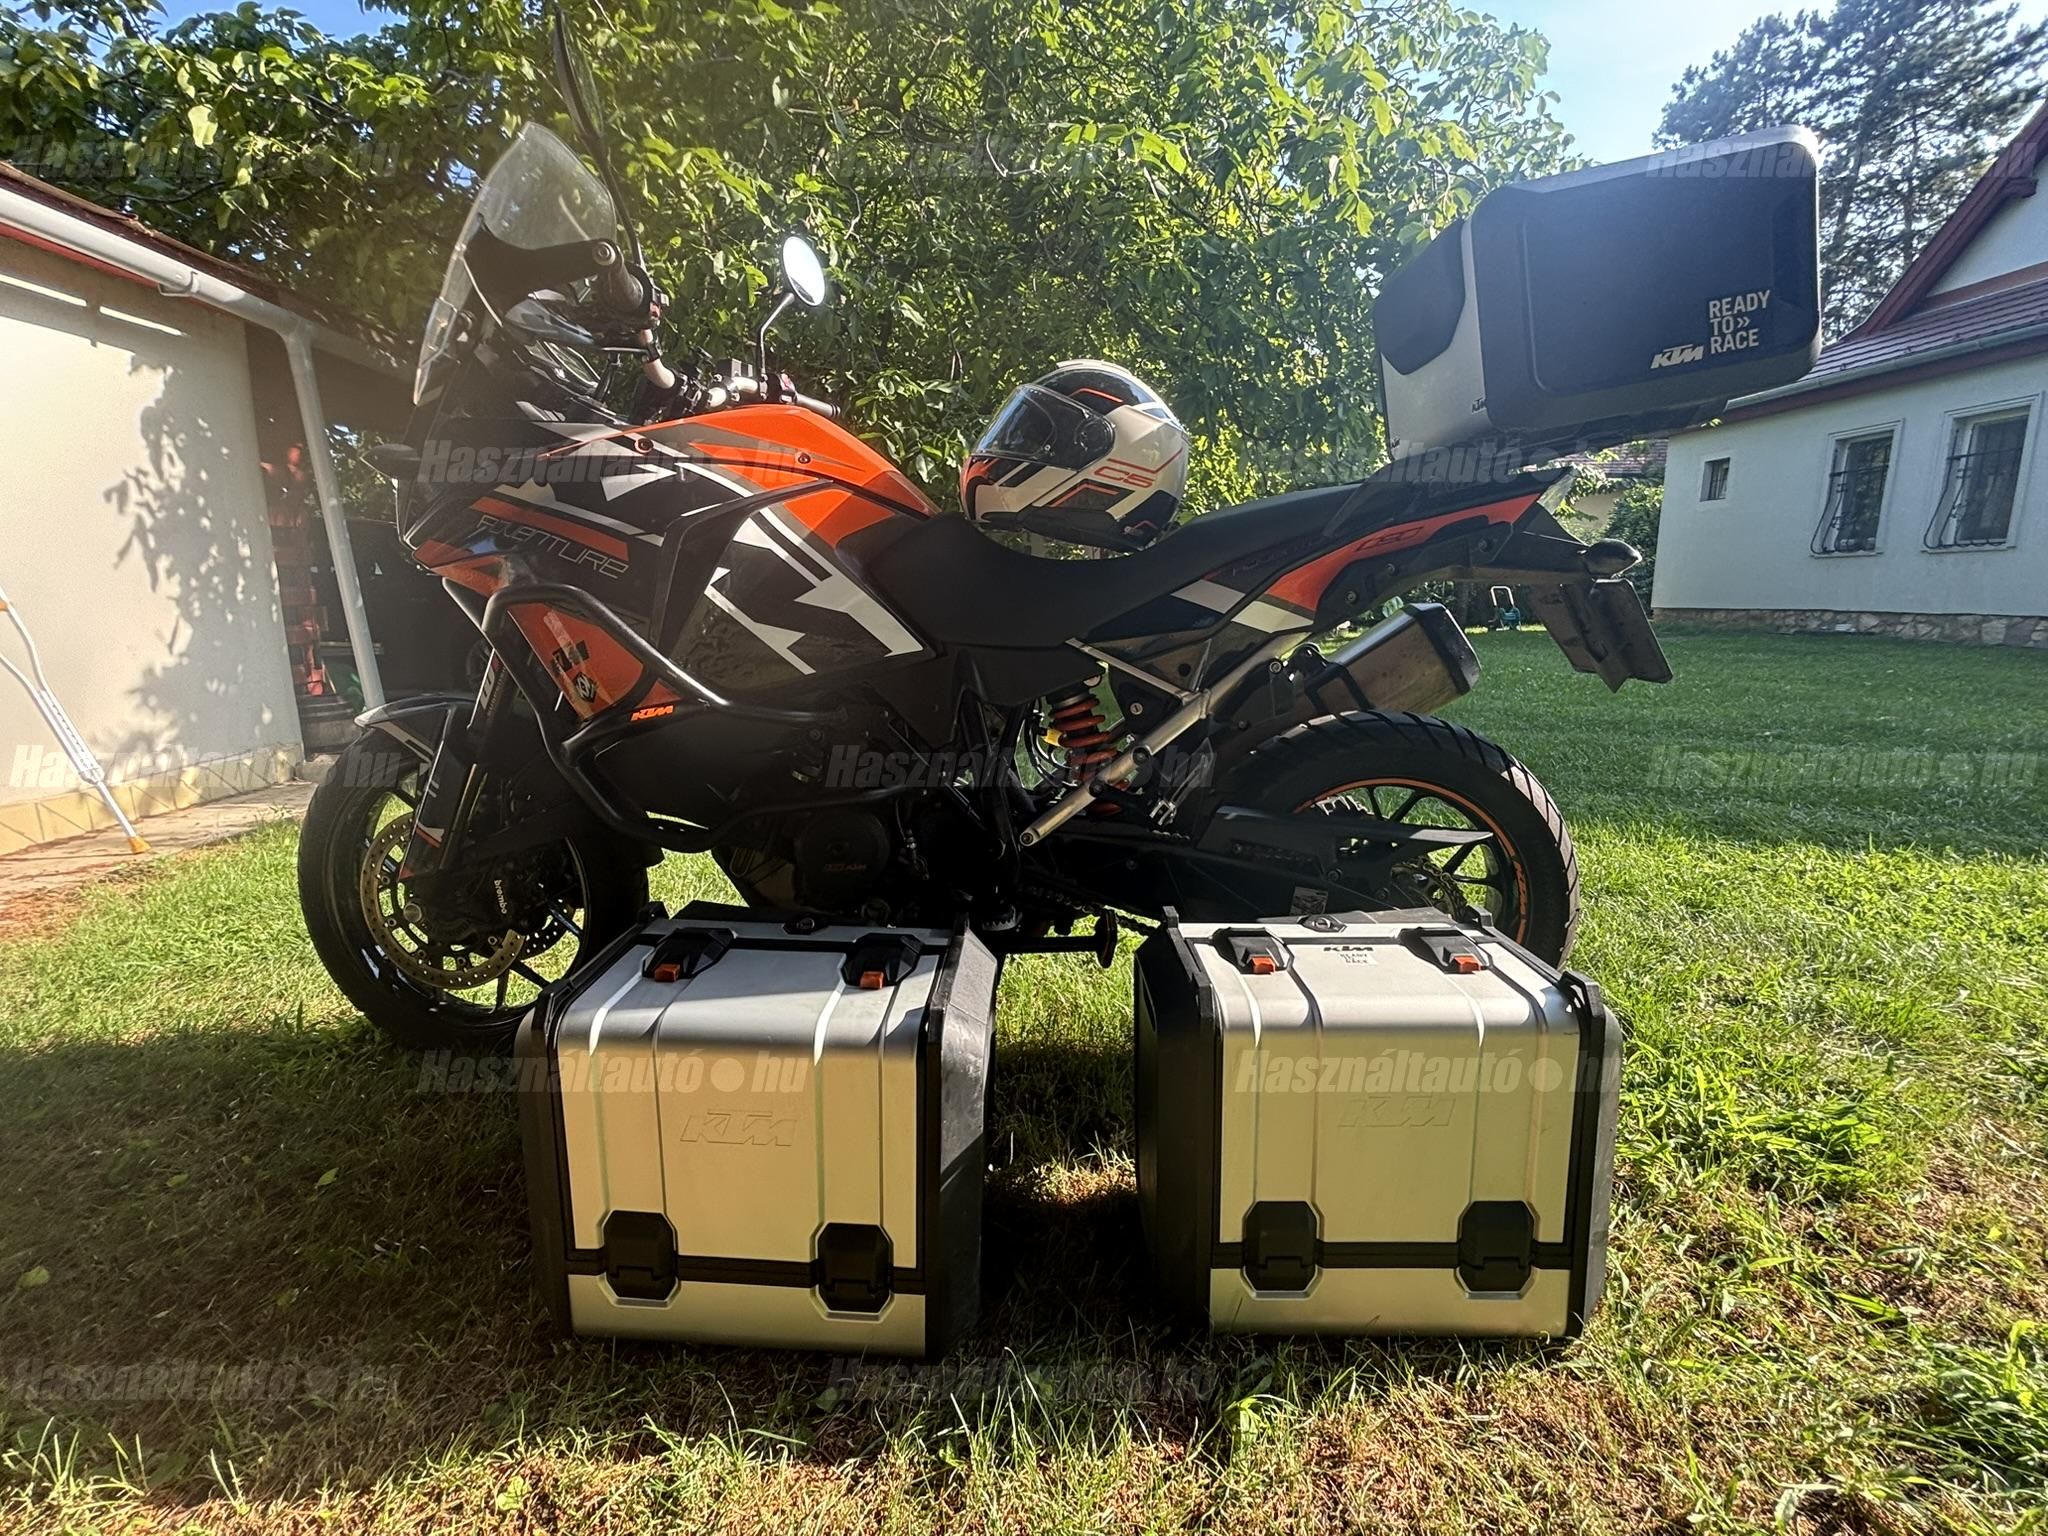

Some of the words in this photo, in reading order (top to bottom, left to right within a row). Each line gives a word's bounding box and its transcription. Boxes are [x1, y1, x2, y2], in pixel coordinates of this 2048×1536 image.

[1708, 289, 1771, 320] READY
[1649, 342, 1705, 369] KTM
[1709, 328, 1761, 355] RACE
[493, 879, 509, 915] brembo
[680, 1109, 798, 1148] KTM
